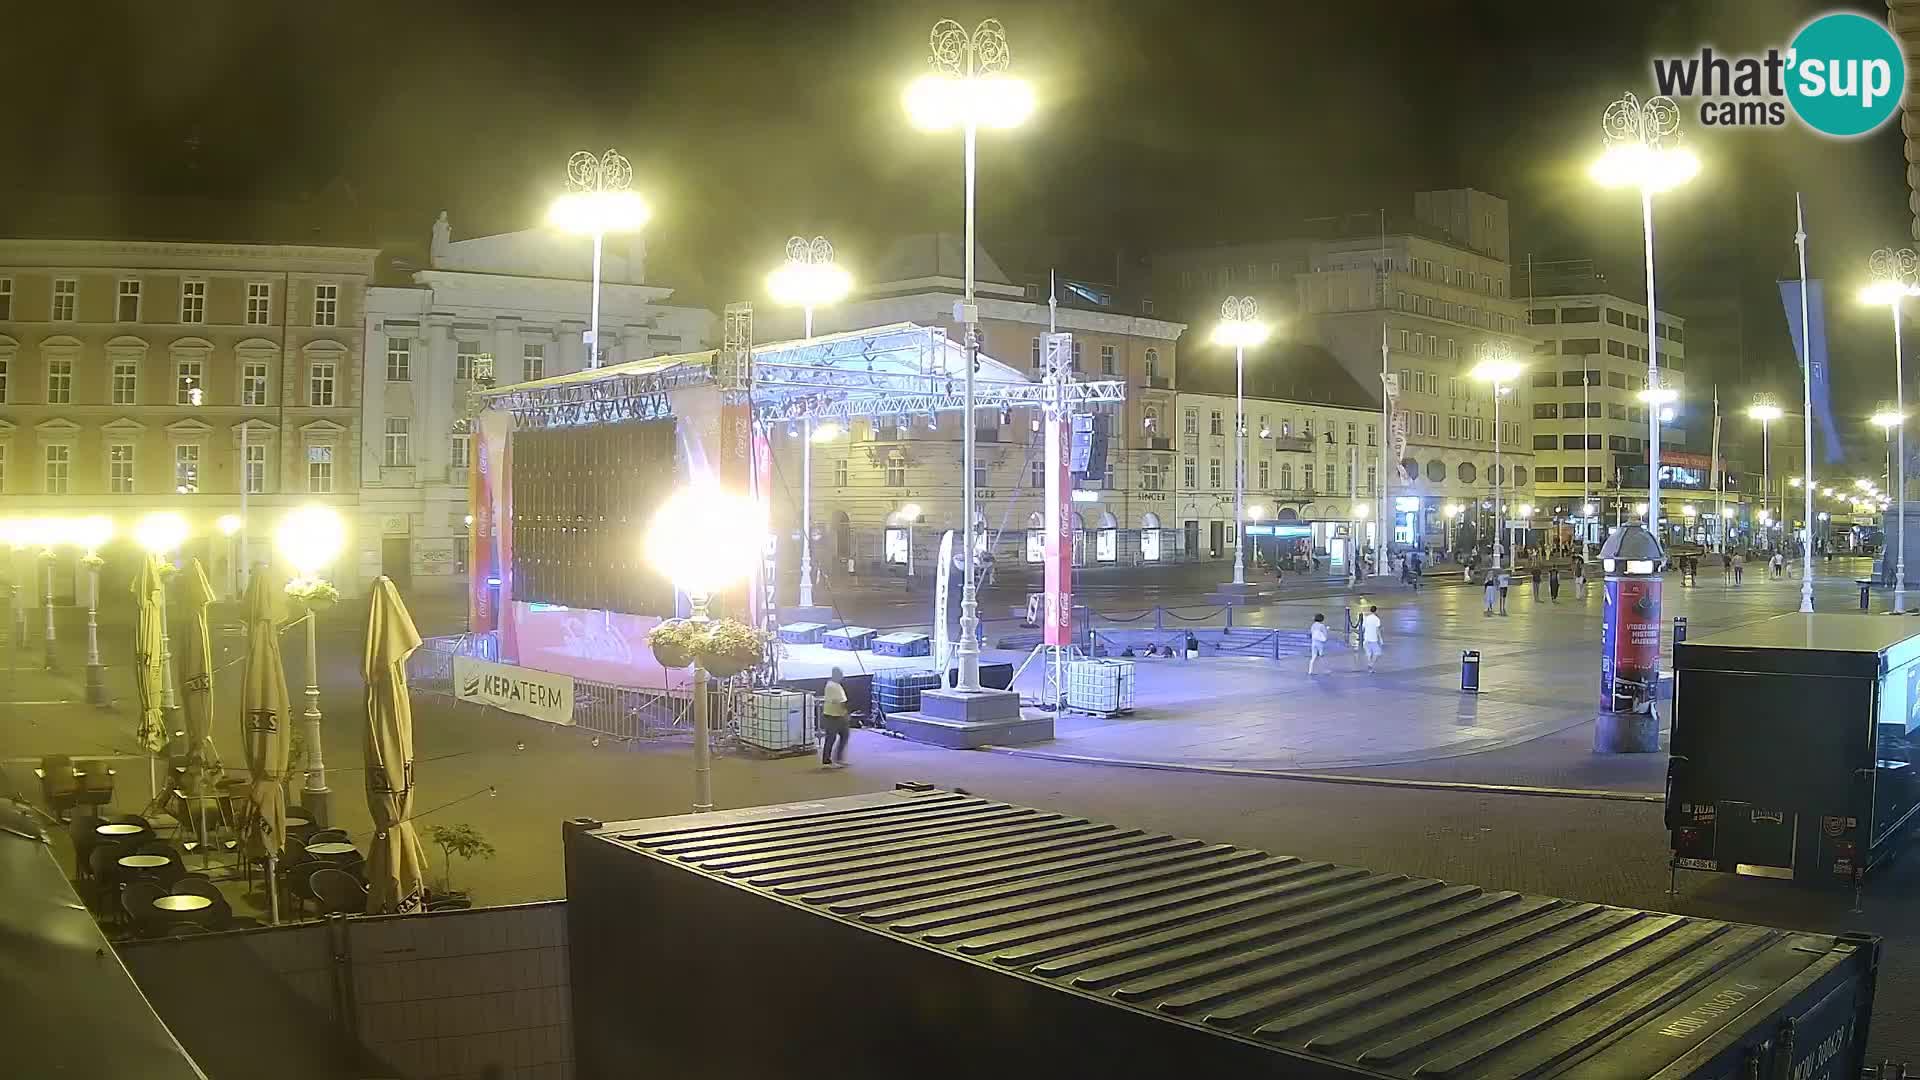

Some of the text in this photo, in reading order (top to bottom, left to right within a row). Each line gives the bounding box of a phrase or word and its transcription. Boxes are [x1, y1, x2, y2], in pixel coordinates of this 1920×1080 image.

[484, 674, 562, 710] KERATERM
[1691, 989, 1747, 1018] 300629
[1736, 983, 1760, 992] 6
